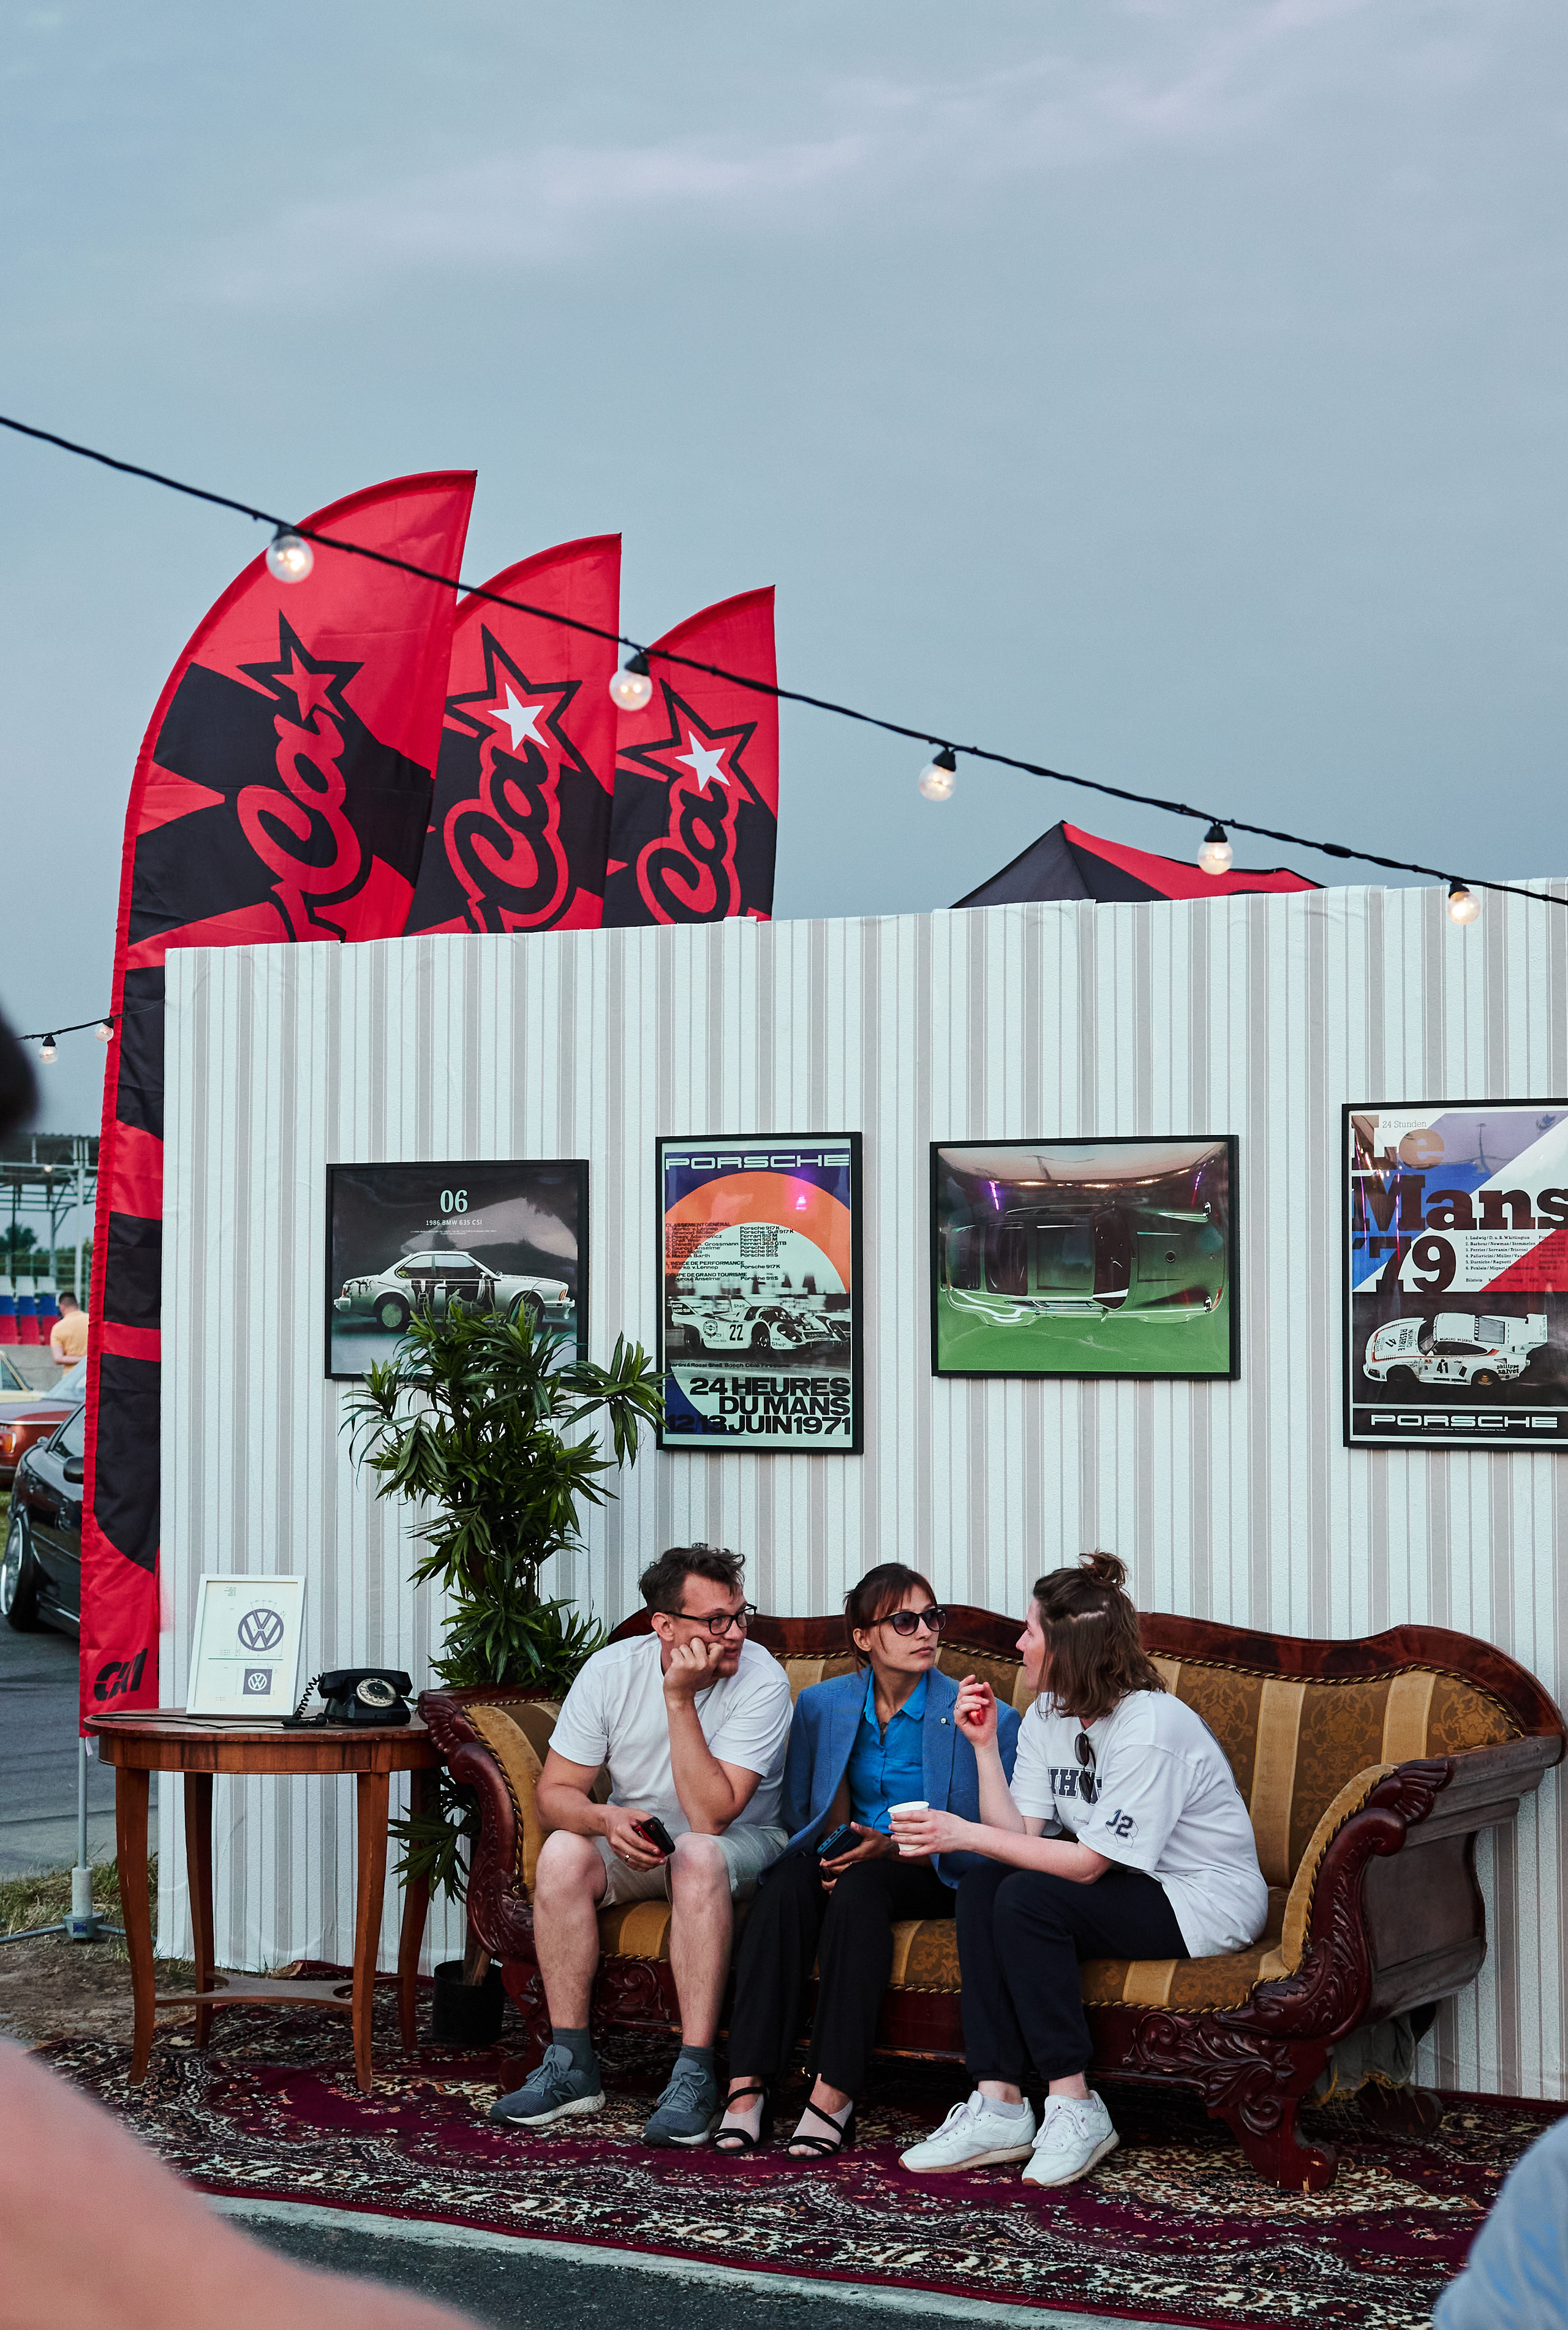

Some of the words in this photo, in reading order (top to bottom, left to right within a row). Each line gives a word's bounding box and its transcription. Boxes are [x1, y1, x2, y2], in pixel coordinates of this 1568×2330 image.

[1352, 1115, 1445, 1171] Le
[665, 1154, 850, 1170] PORSCHE
[440, 1190, 468, 1213] 06
[1352, 1175, 1568, 1231] Mans
[729, 1324, 744, 1341] 22
[1436, 1362, 1449, 1373] 41
[690, 1378, 728, 1396] 24
[732, 1377, 851, 1397] HEURES
[719, 1396, 759, 1415] DU
[763, 1397, 851, 1416] MANS
[728, 1415, 793, 1435] JUIN
[793, 1416, 851, 1435] 1971
[1371, 1414, 1558, 1428] PORSCHE
